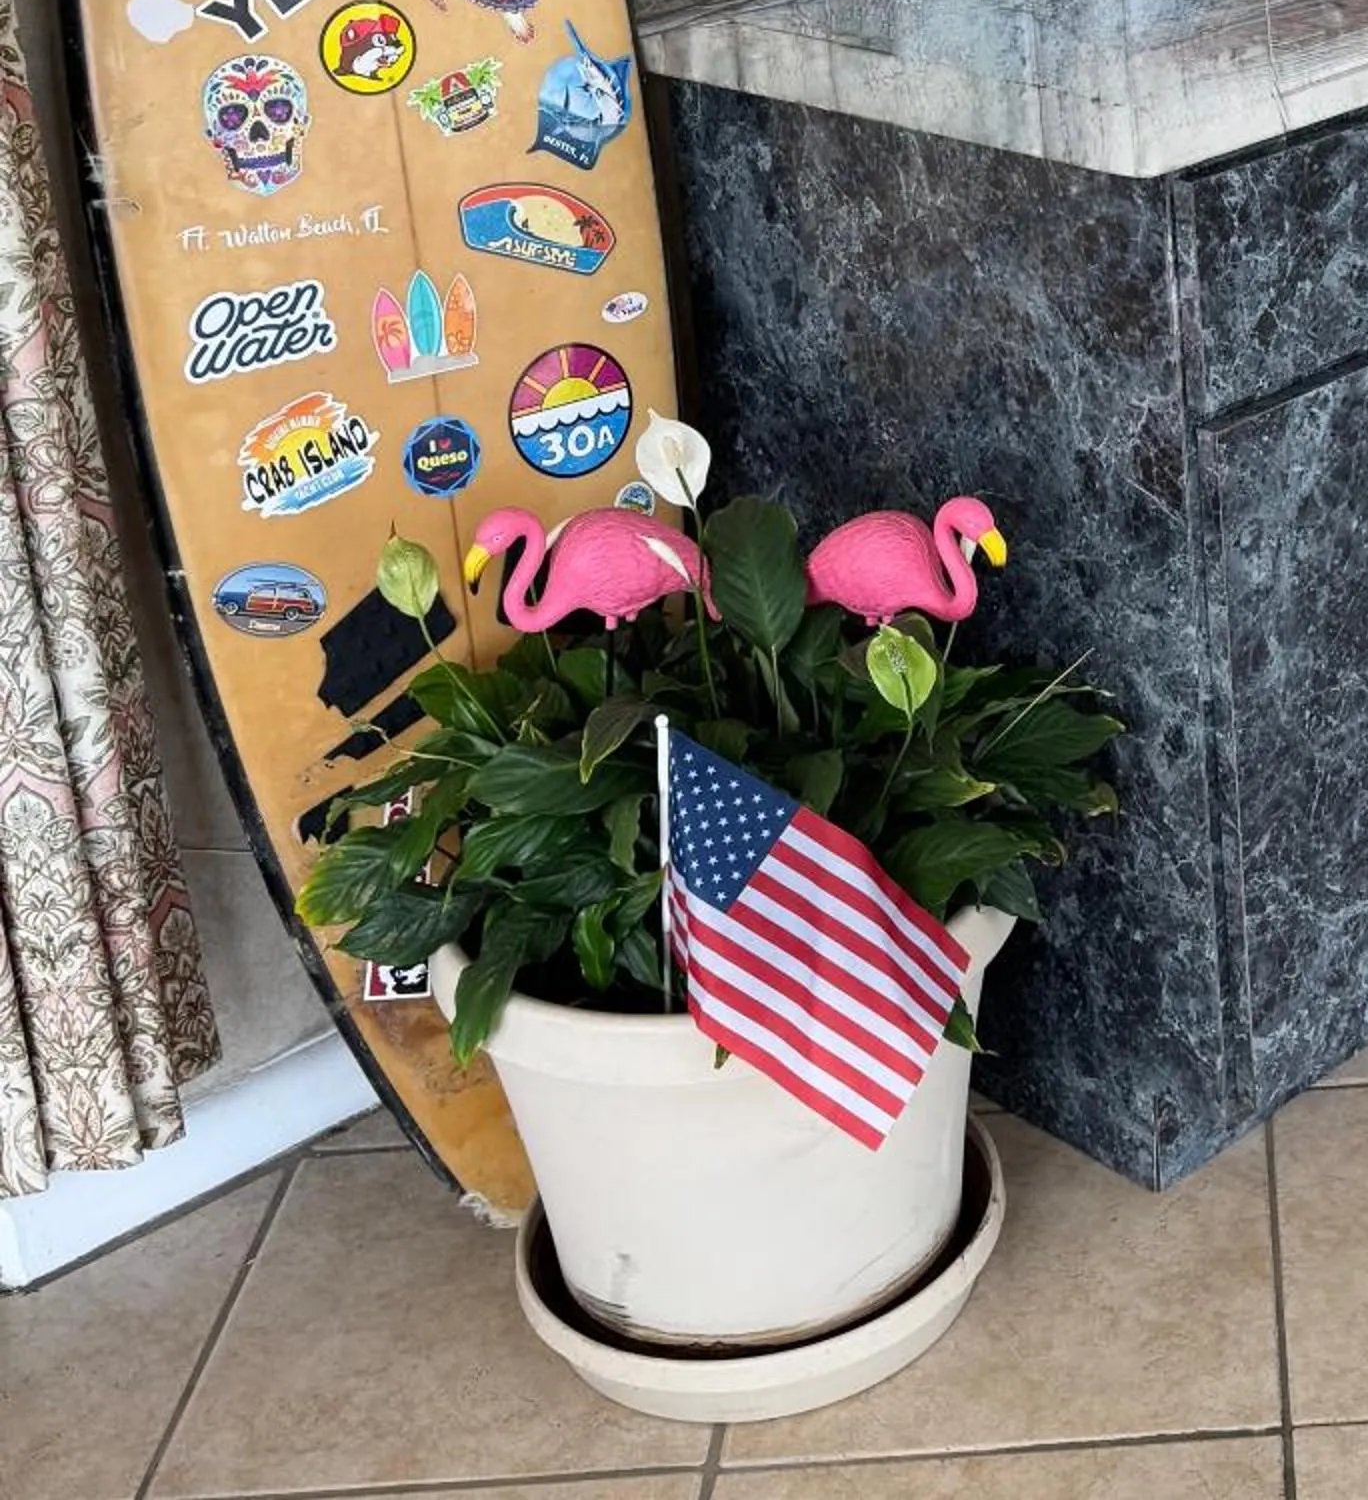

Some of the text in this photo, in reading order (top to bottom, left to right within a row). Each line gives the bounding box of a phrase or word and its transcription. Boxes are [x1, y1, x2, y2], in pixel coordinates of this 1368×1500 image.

[217, 221, 292, 248] Walton
[294, 213, 361, 238] Beach,
[195, 284, 318, 339] Open
[246, 455, 296, 504] CRAB
[297, 418, 369, 478] ISLAND
[417, 450, 469, 472] Queso
[429, 439, 437, 453] I
[539, 425, 616, 467] 30A
